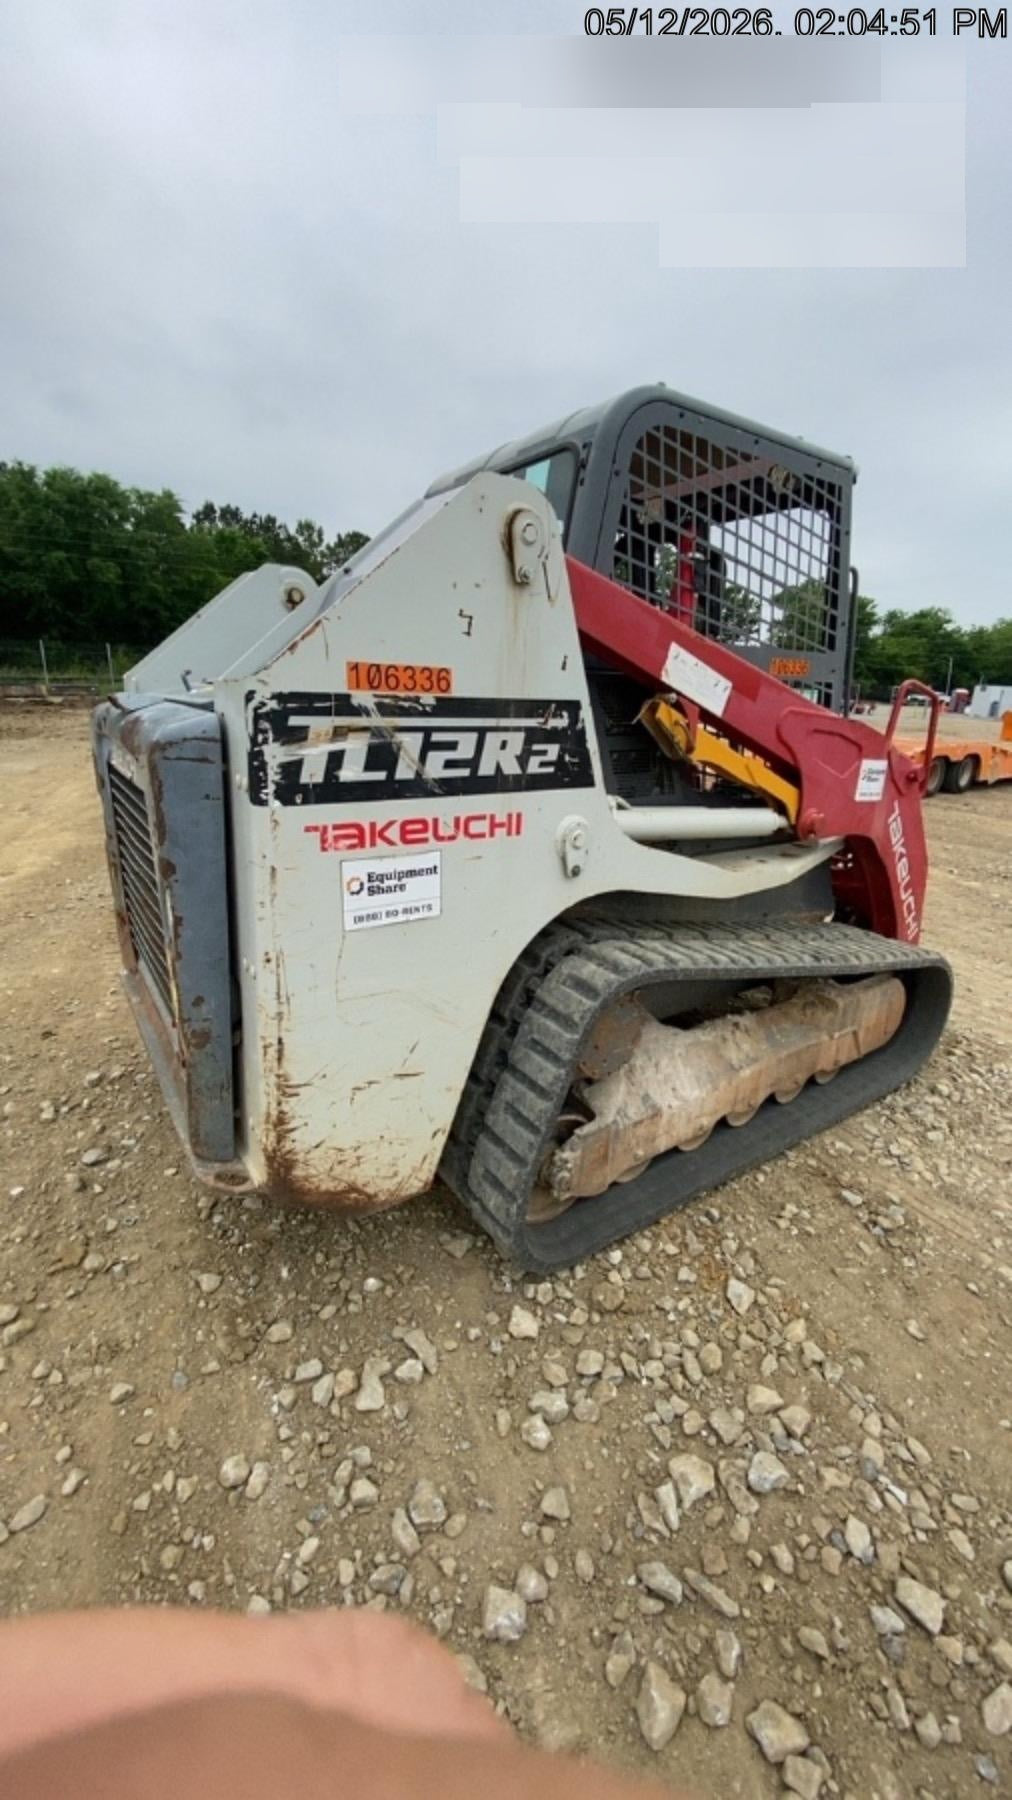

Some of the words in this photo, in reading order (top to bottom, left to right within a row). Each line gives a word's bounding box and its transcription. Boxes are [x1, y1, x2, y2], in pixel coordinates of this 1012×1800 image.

[349, 662, 452, 692] 106336
[304, 812, 522, 852] TAKEUCHI
[367, 865, 438, 884] Equipment
[367, 883, 407, 897] Share
